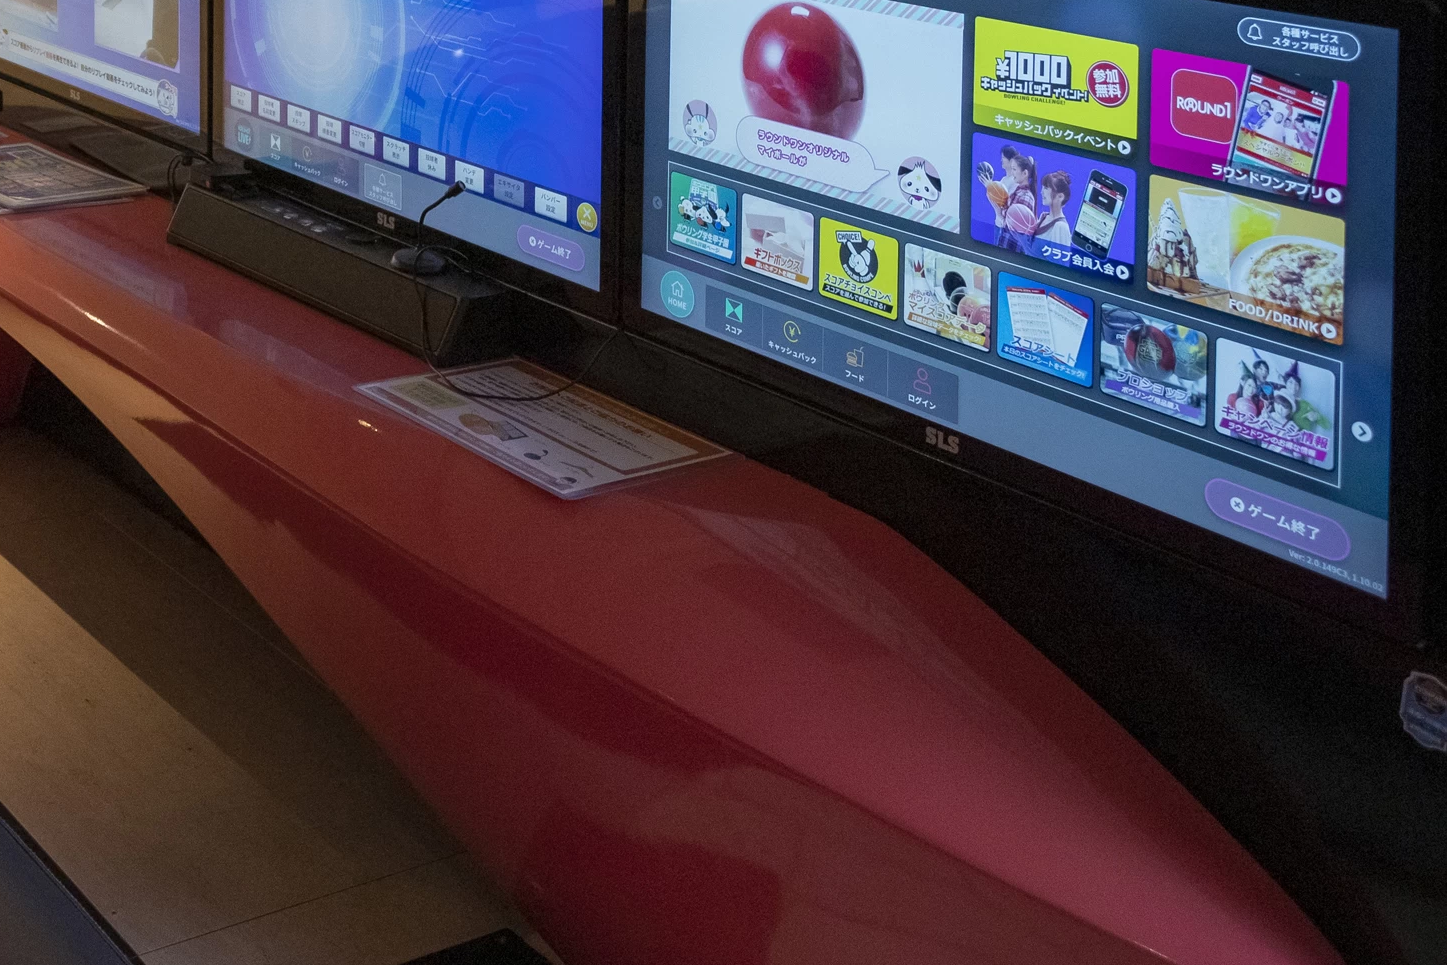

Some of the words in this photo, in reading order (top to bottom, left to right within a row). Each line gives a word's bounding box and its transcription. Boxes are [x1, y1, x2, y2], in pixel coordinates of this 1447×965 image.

[1272, 36, 1349, 57] スタッフ呼び出し
[1281, 26, 1339, 44] 各種サービス
[996, 50, 1070, 85] ¥1000
[1092, 68, 1119, 83] 参加
[1004, 94, 1030, 102] BOWLING
[1030, 96, 1066, 106] CHALLENGE!
[1094, 83, 1122, 98] 無料
[1176, 96, 1232, 119] ROUND1
[994, 114, 1116, 151] キャッシュバックイベント
[386, 140, 406, 152] スクラッチ
[757, 129, 850, 163] ラウンドワンオリジナル
[757, 144, 807, 167] マイボールが
[1211, 163, 1323, 199] ラウンドワンアプリ
[540, 193, 561, 204] バンパー
[377, 212, 395, 229] SLS
[837, 233, 860, 241] CHOICE!
[537, 239, 572, 259] ゲーム終了
[754, 248, 802, 273] ギフトボックス
[1041, 245, 1115, 276] クラブ会員入会
[824, 273, 891, 303] スコアチョイスコンペ
[668, 297, 687, 311] HOME
[909, 301, 986, 334] マイスコアデータ
[1228, 298, 1320, 334] FOOD/DRINK
[725, 324, 742, 336] スコア
[768, 340, 817, 364] キャッシュバック
[1011, 335, 1076, 364] スコアシート
[845, 370, 864, 382] フード
[1117, 368, 1191, 402] プロショップ
[908, 394, 936, 410] ログイン
[1221, 406, 1329, 449] キャンペーン情報
[926, 426, 959, 454] SLS
[1248, 504, 1320, 540] ゲーム終了
